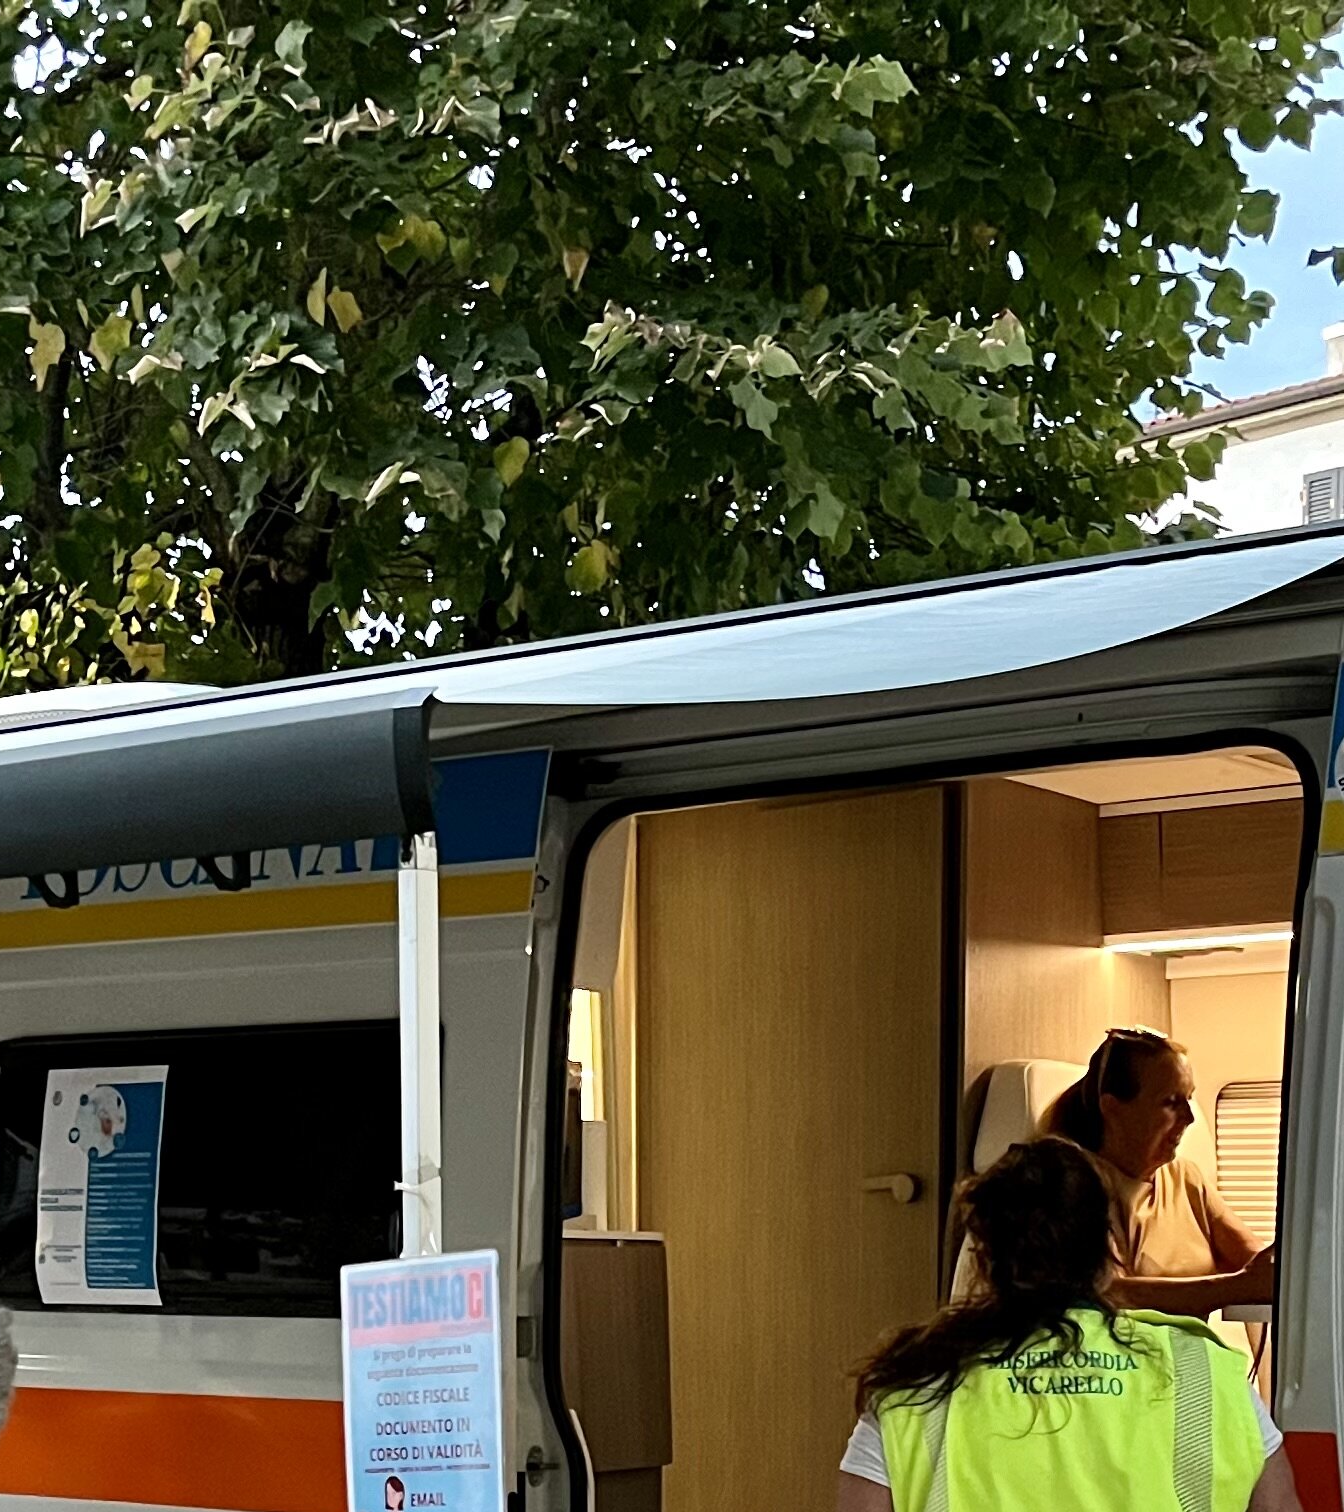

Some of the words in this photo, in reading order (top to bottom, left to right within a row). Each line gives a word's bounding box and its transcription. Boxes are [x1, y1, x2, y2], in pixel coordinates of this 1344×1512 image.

[350, 1271, 493, 1329] TESTIAMOCI
[1007, 1375, 1124, 1396] VICARELLO
[376, 1391, 420, 1407] CODICE
[422, 1387, 471, 1404] FISCALE
[375, 1418, 454, 1436] DOCUMENTO
[456, 1417, 471, 1433] IN
[369, 1447, 408, 1462] CORSO
[412, 1446, 425, 1460] DI
[428, 1439, 484, 1460] VALIDITÀ
[410, 1492, 446, 1507] EMAIL
